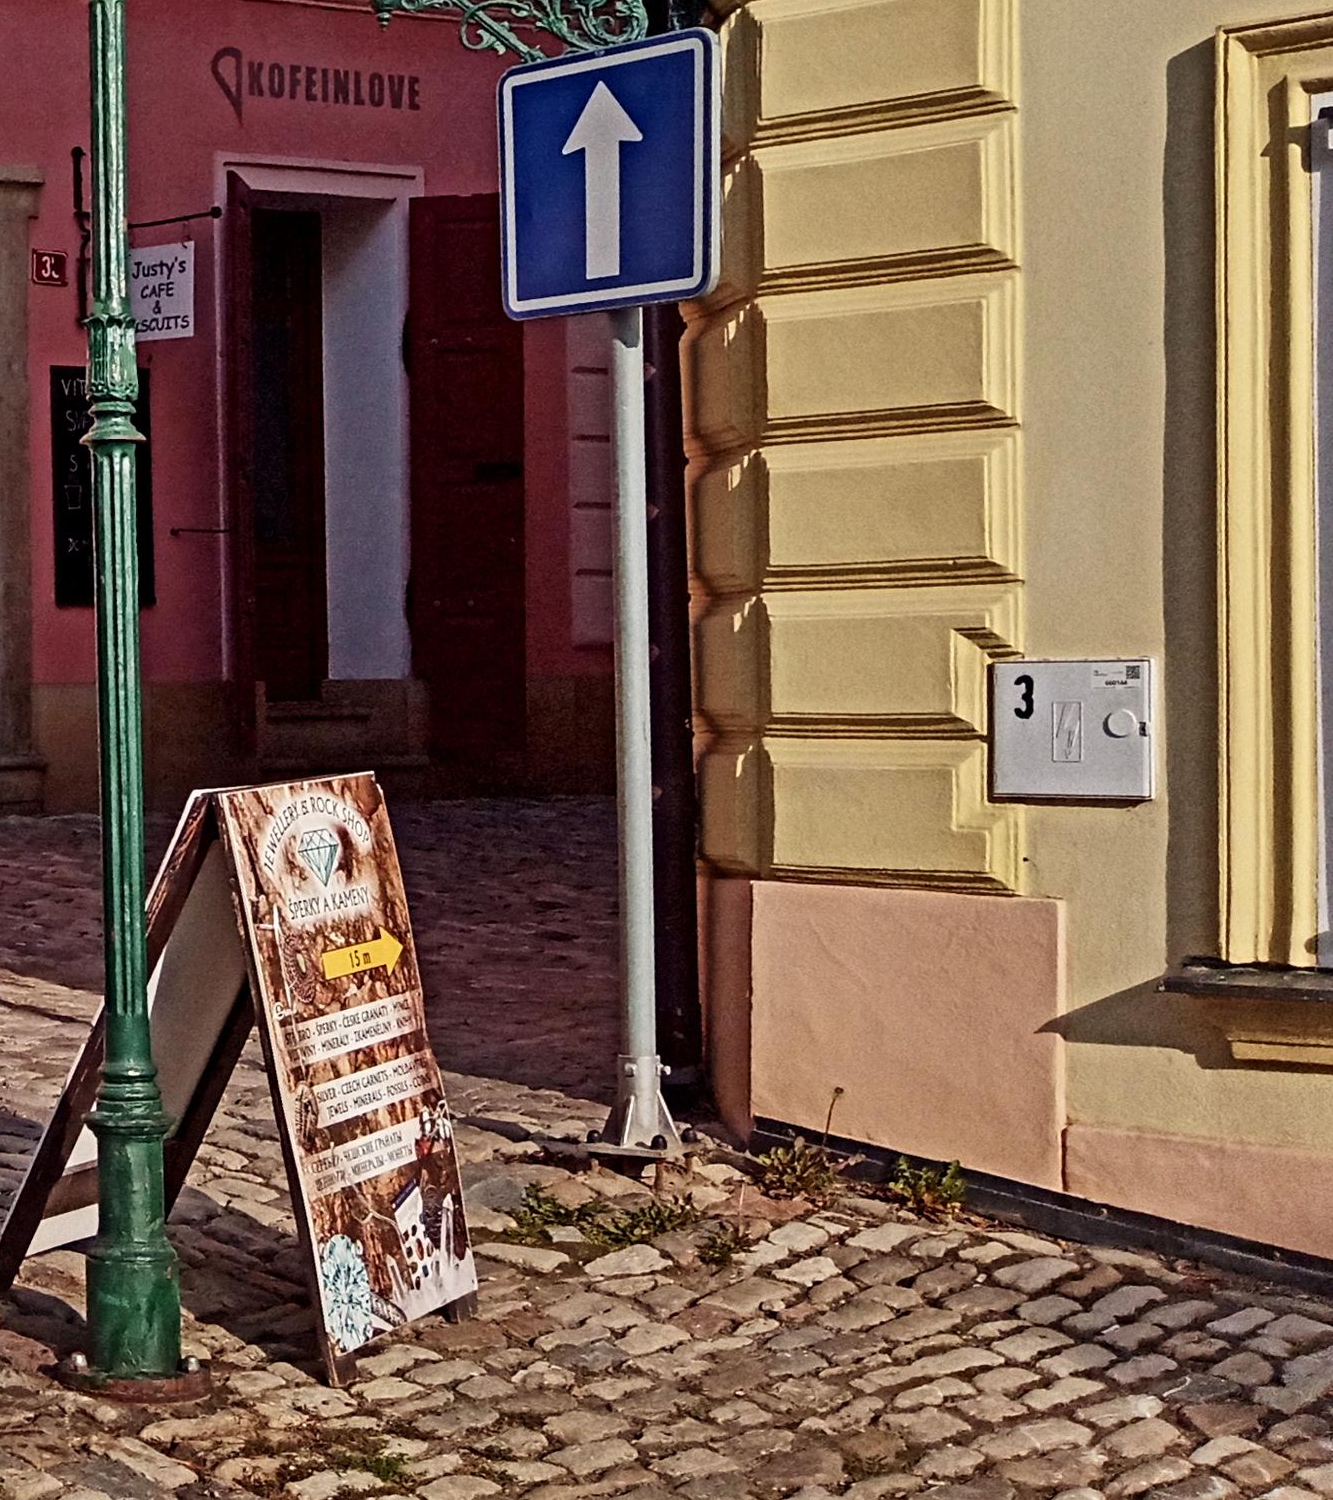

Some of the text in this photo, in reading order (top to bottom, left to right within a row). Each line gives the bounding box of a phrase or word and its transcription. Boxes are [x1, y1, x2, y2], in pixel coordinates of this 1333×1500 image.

[248, 61, 420, 111] KOFEINLOVE
[132, 256, 186, 280] Justy's
[141, 282, 174, 299] CAFE
[153, 300, 161, 314] &
[135, 315, 189, 333] ISCUITS
[1014, 674, 1034, 719] 3
[264, 802, 299, 873] JEWELLERY
[310, 797, 341, 818] ROCK
[342, 808, 369, 842] SHOP
[289, 886, 369, 920] ŠPERKY A KAMENY
[349, 950, 371, 968] 15 m
[341, 1080, 361, 1095] CZECH
